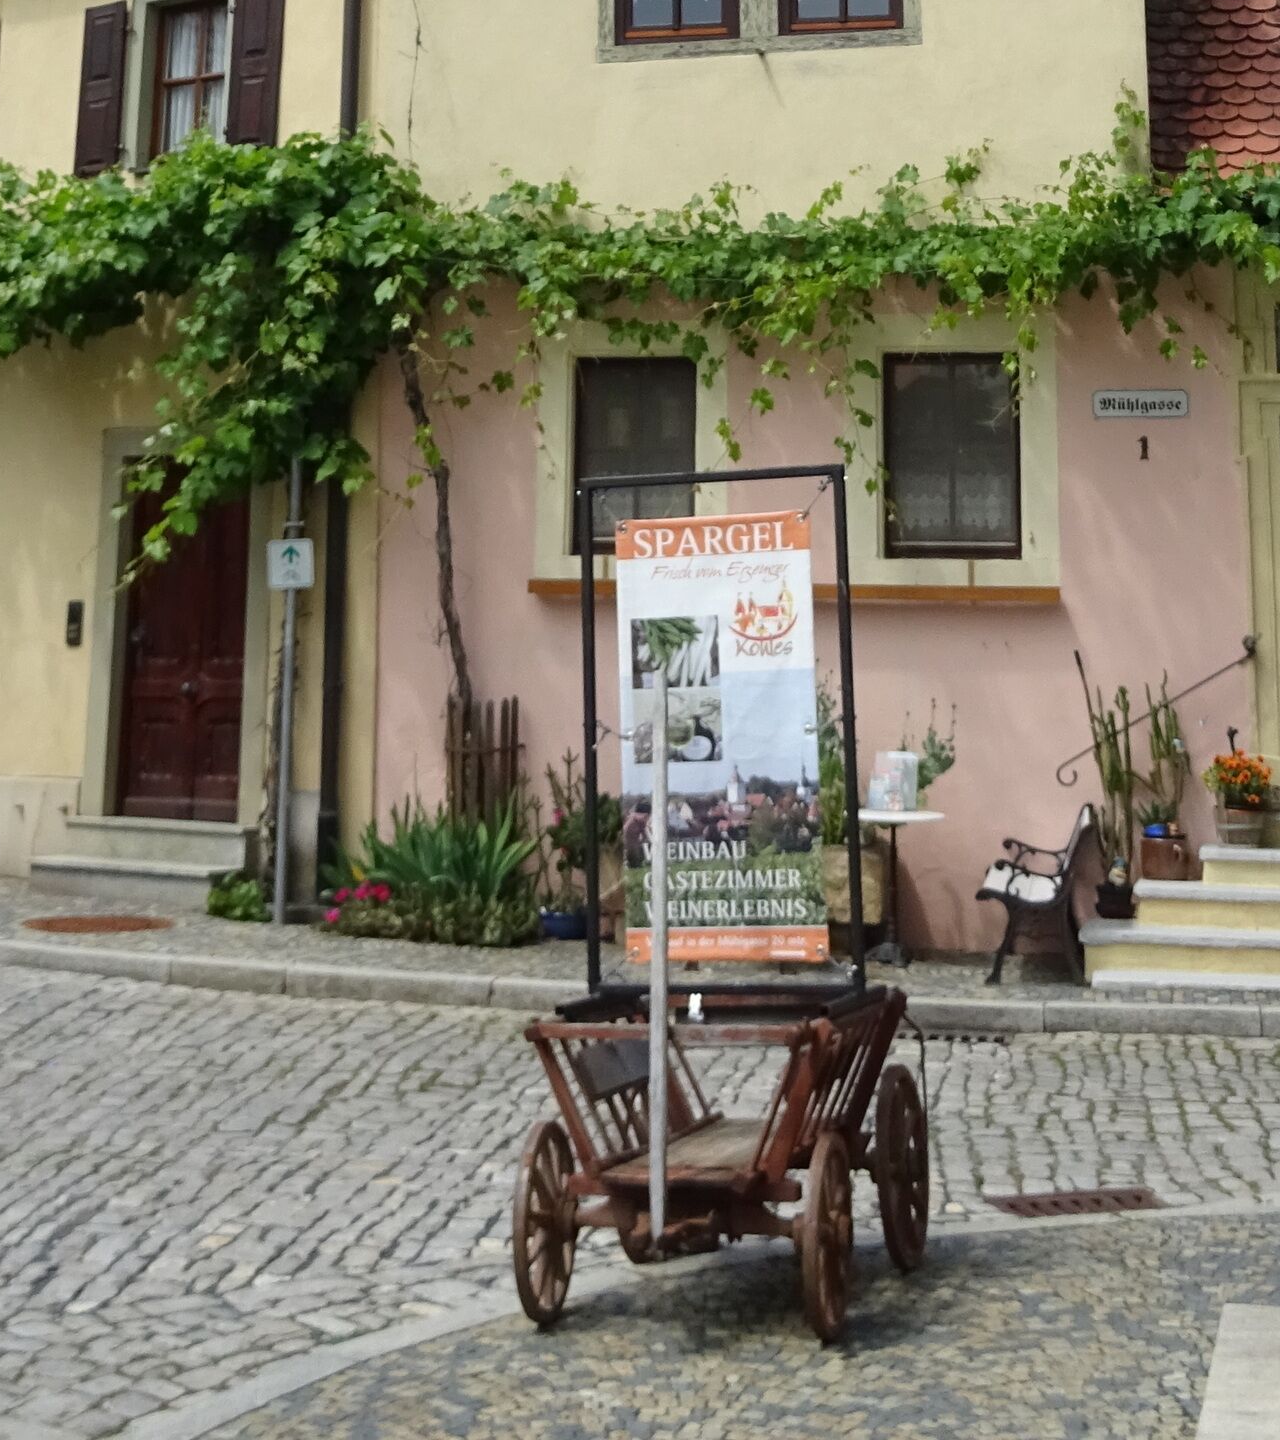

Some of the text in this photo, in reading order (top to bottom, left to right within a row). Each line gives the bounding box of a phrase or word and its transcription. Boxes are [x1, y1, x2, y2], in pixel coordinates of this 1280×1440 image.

[1099, 397, 1182, 414] Mühlgasse
[1137, 435, 1149, 460] 1
[633, 521, 794, 558] SPARGEL
[652, 562, 692, 579] Frisch
[696, 566, 722, 578] vom
